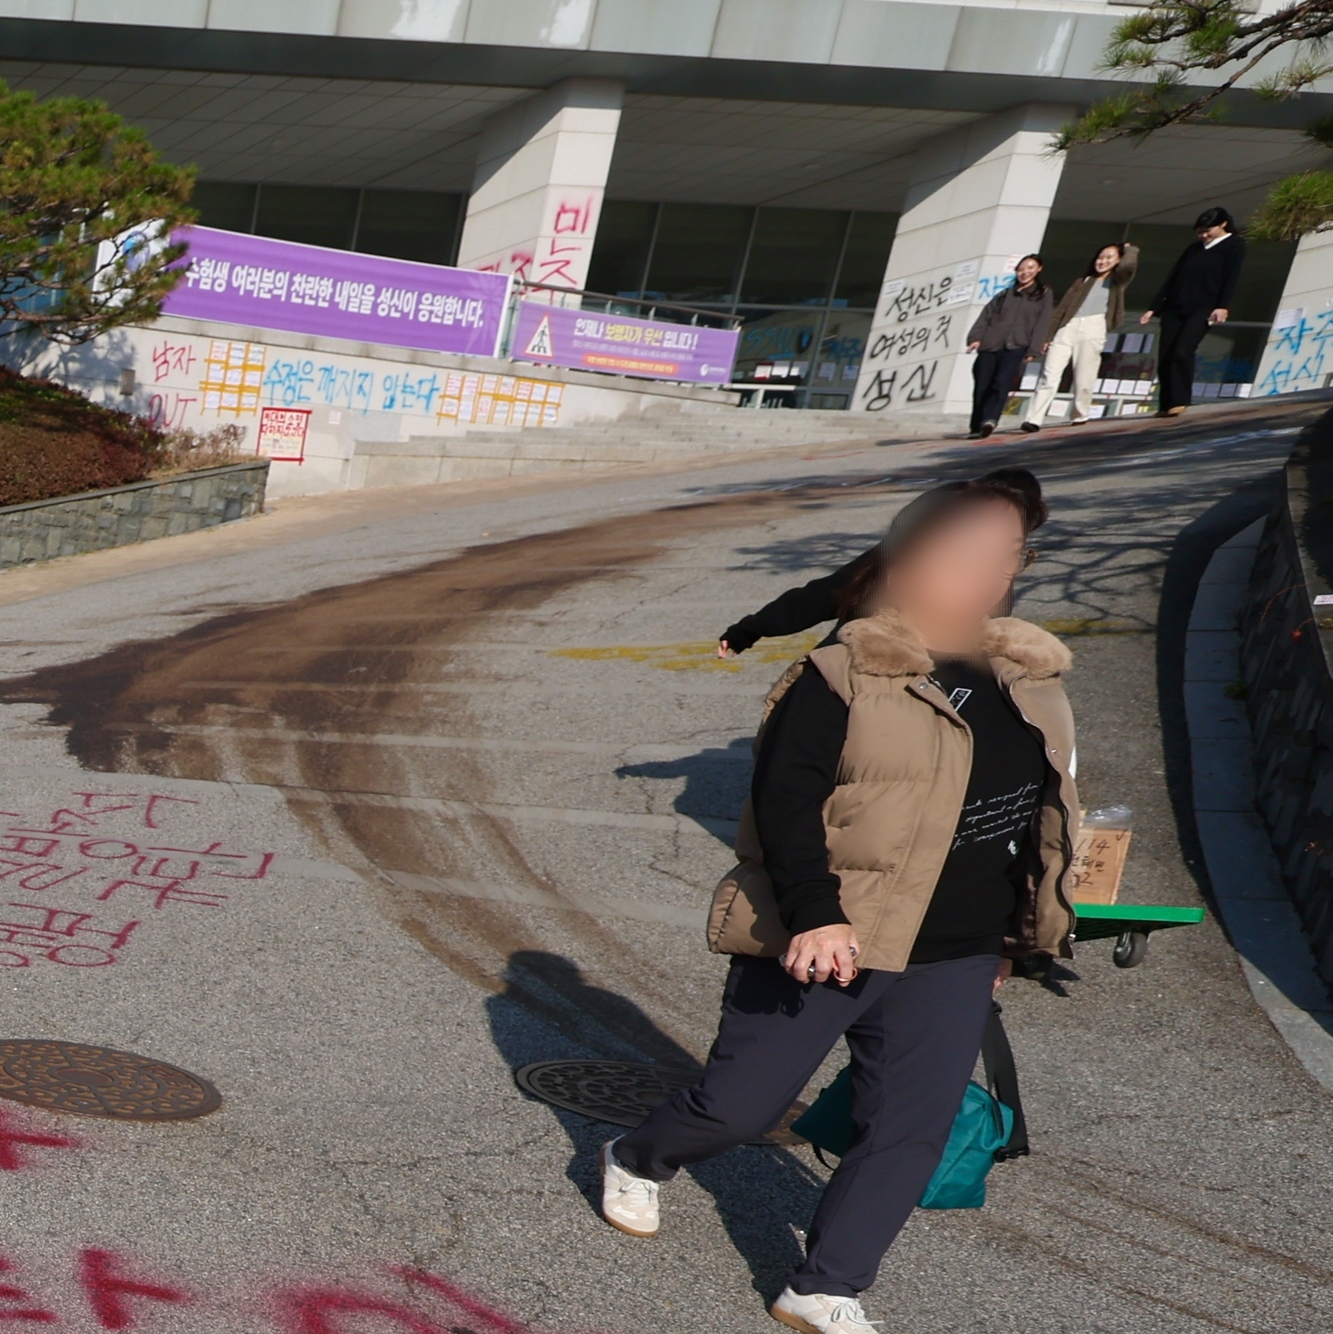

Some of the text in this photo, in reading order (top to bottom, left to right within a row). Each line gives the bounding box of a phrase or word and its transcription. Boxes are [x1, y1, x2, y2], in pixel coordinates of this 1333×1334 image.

[185, 257, 484, 328] 수험생 여러분의 찬란한 내일을 성신이 응원합니다.
[885, 277, 952, 322] 성신은
[574, 318, 604, 338] 언제나
[605, 323, 642, 343] 보행자가
[644, 328, 663, 346] 우선
[870, 315, 952, 360] 여성의 것
[152, 341, 196, 383] 남자
[263, 358, 314, 406] 수정은
[863, 360, 938, 411] 성신
